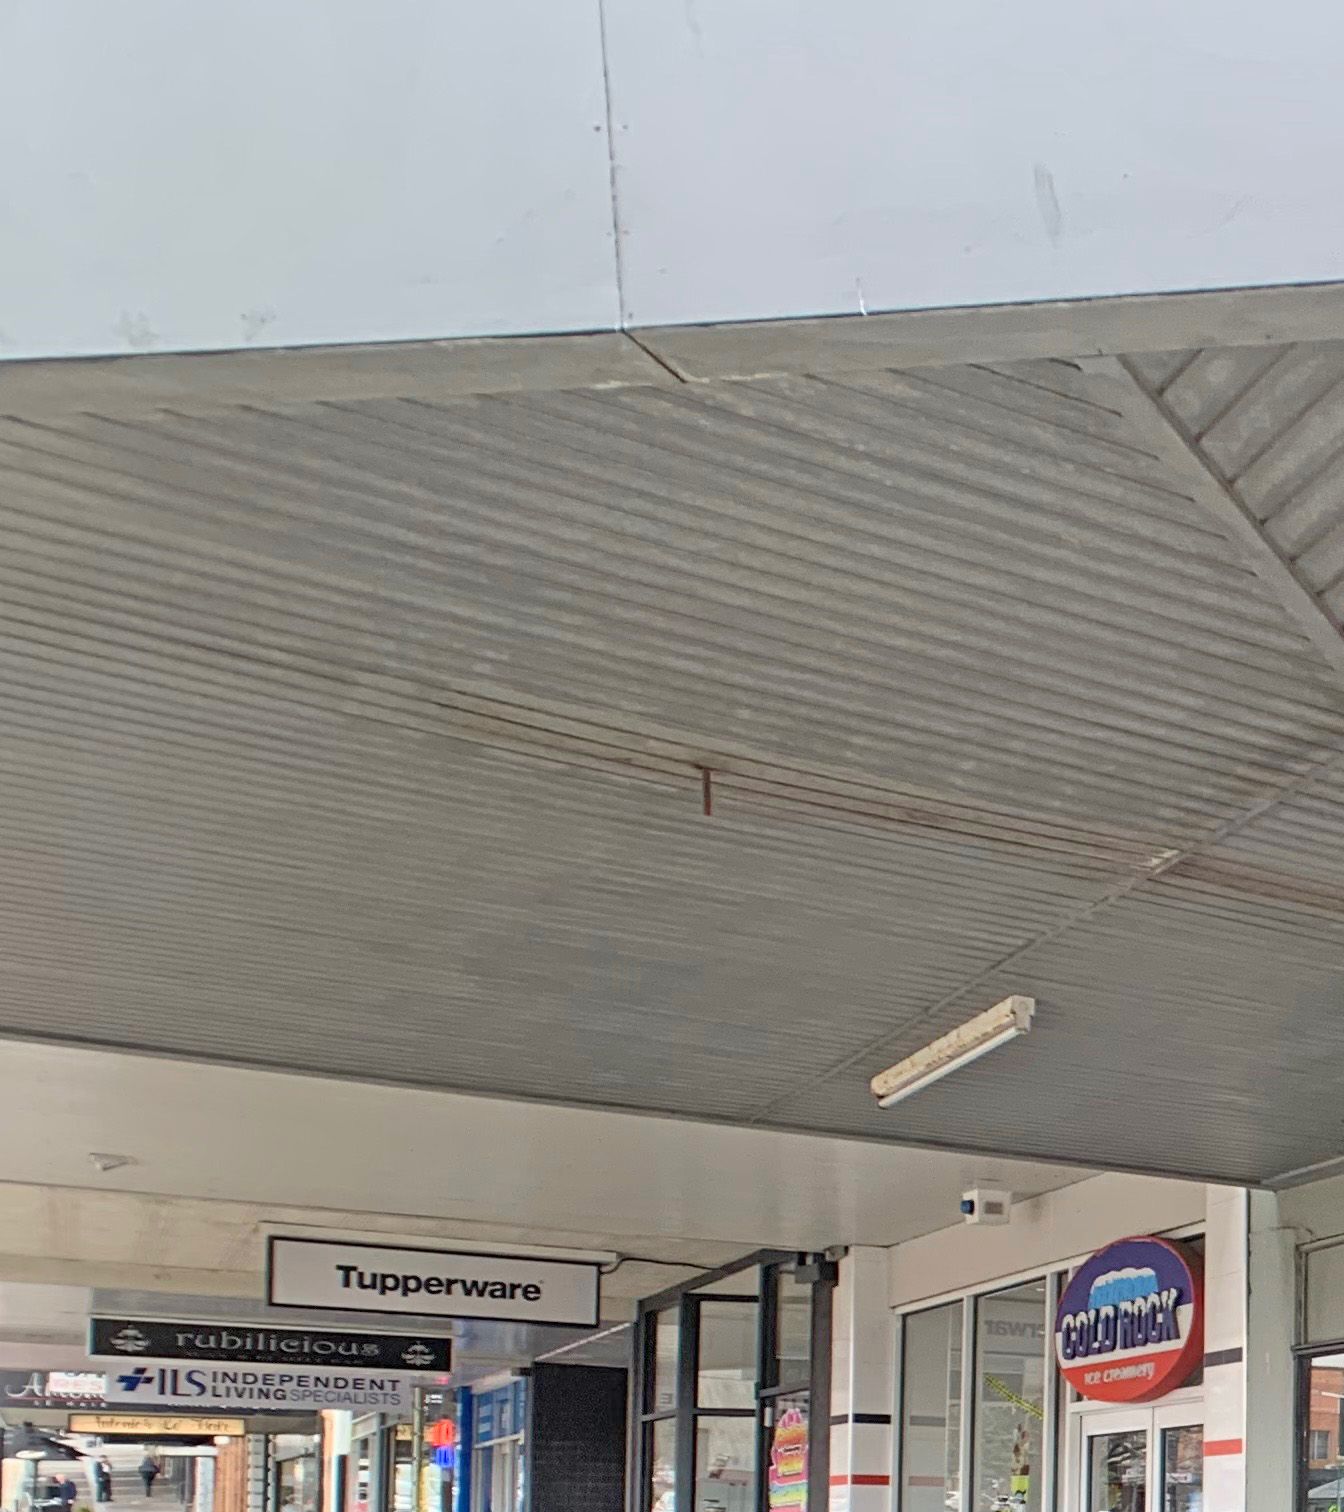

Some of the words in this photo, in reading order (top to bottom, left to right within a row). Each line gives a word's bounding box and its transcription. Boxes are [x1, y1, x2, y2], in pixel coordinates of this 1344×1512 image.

[336, 1264, 541, 1301] Tupperware
[1062, 1304, 1118, 1360] COLD
[1119, 1287, 1183, 1350] ROCK
[176, 1331, 380, 1357] rubilicious
[157, 1368, 207, 1398] ILS
[210, 1386, 288, 1402] LIVING
[289, 1388, 402, 1406] SPECIALISTS
[211, 1371, 401, 1393] INDEPENDENT
